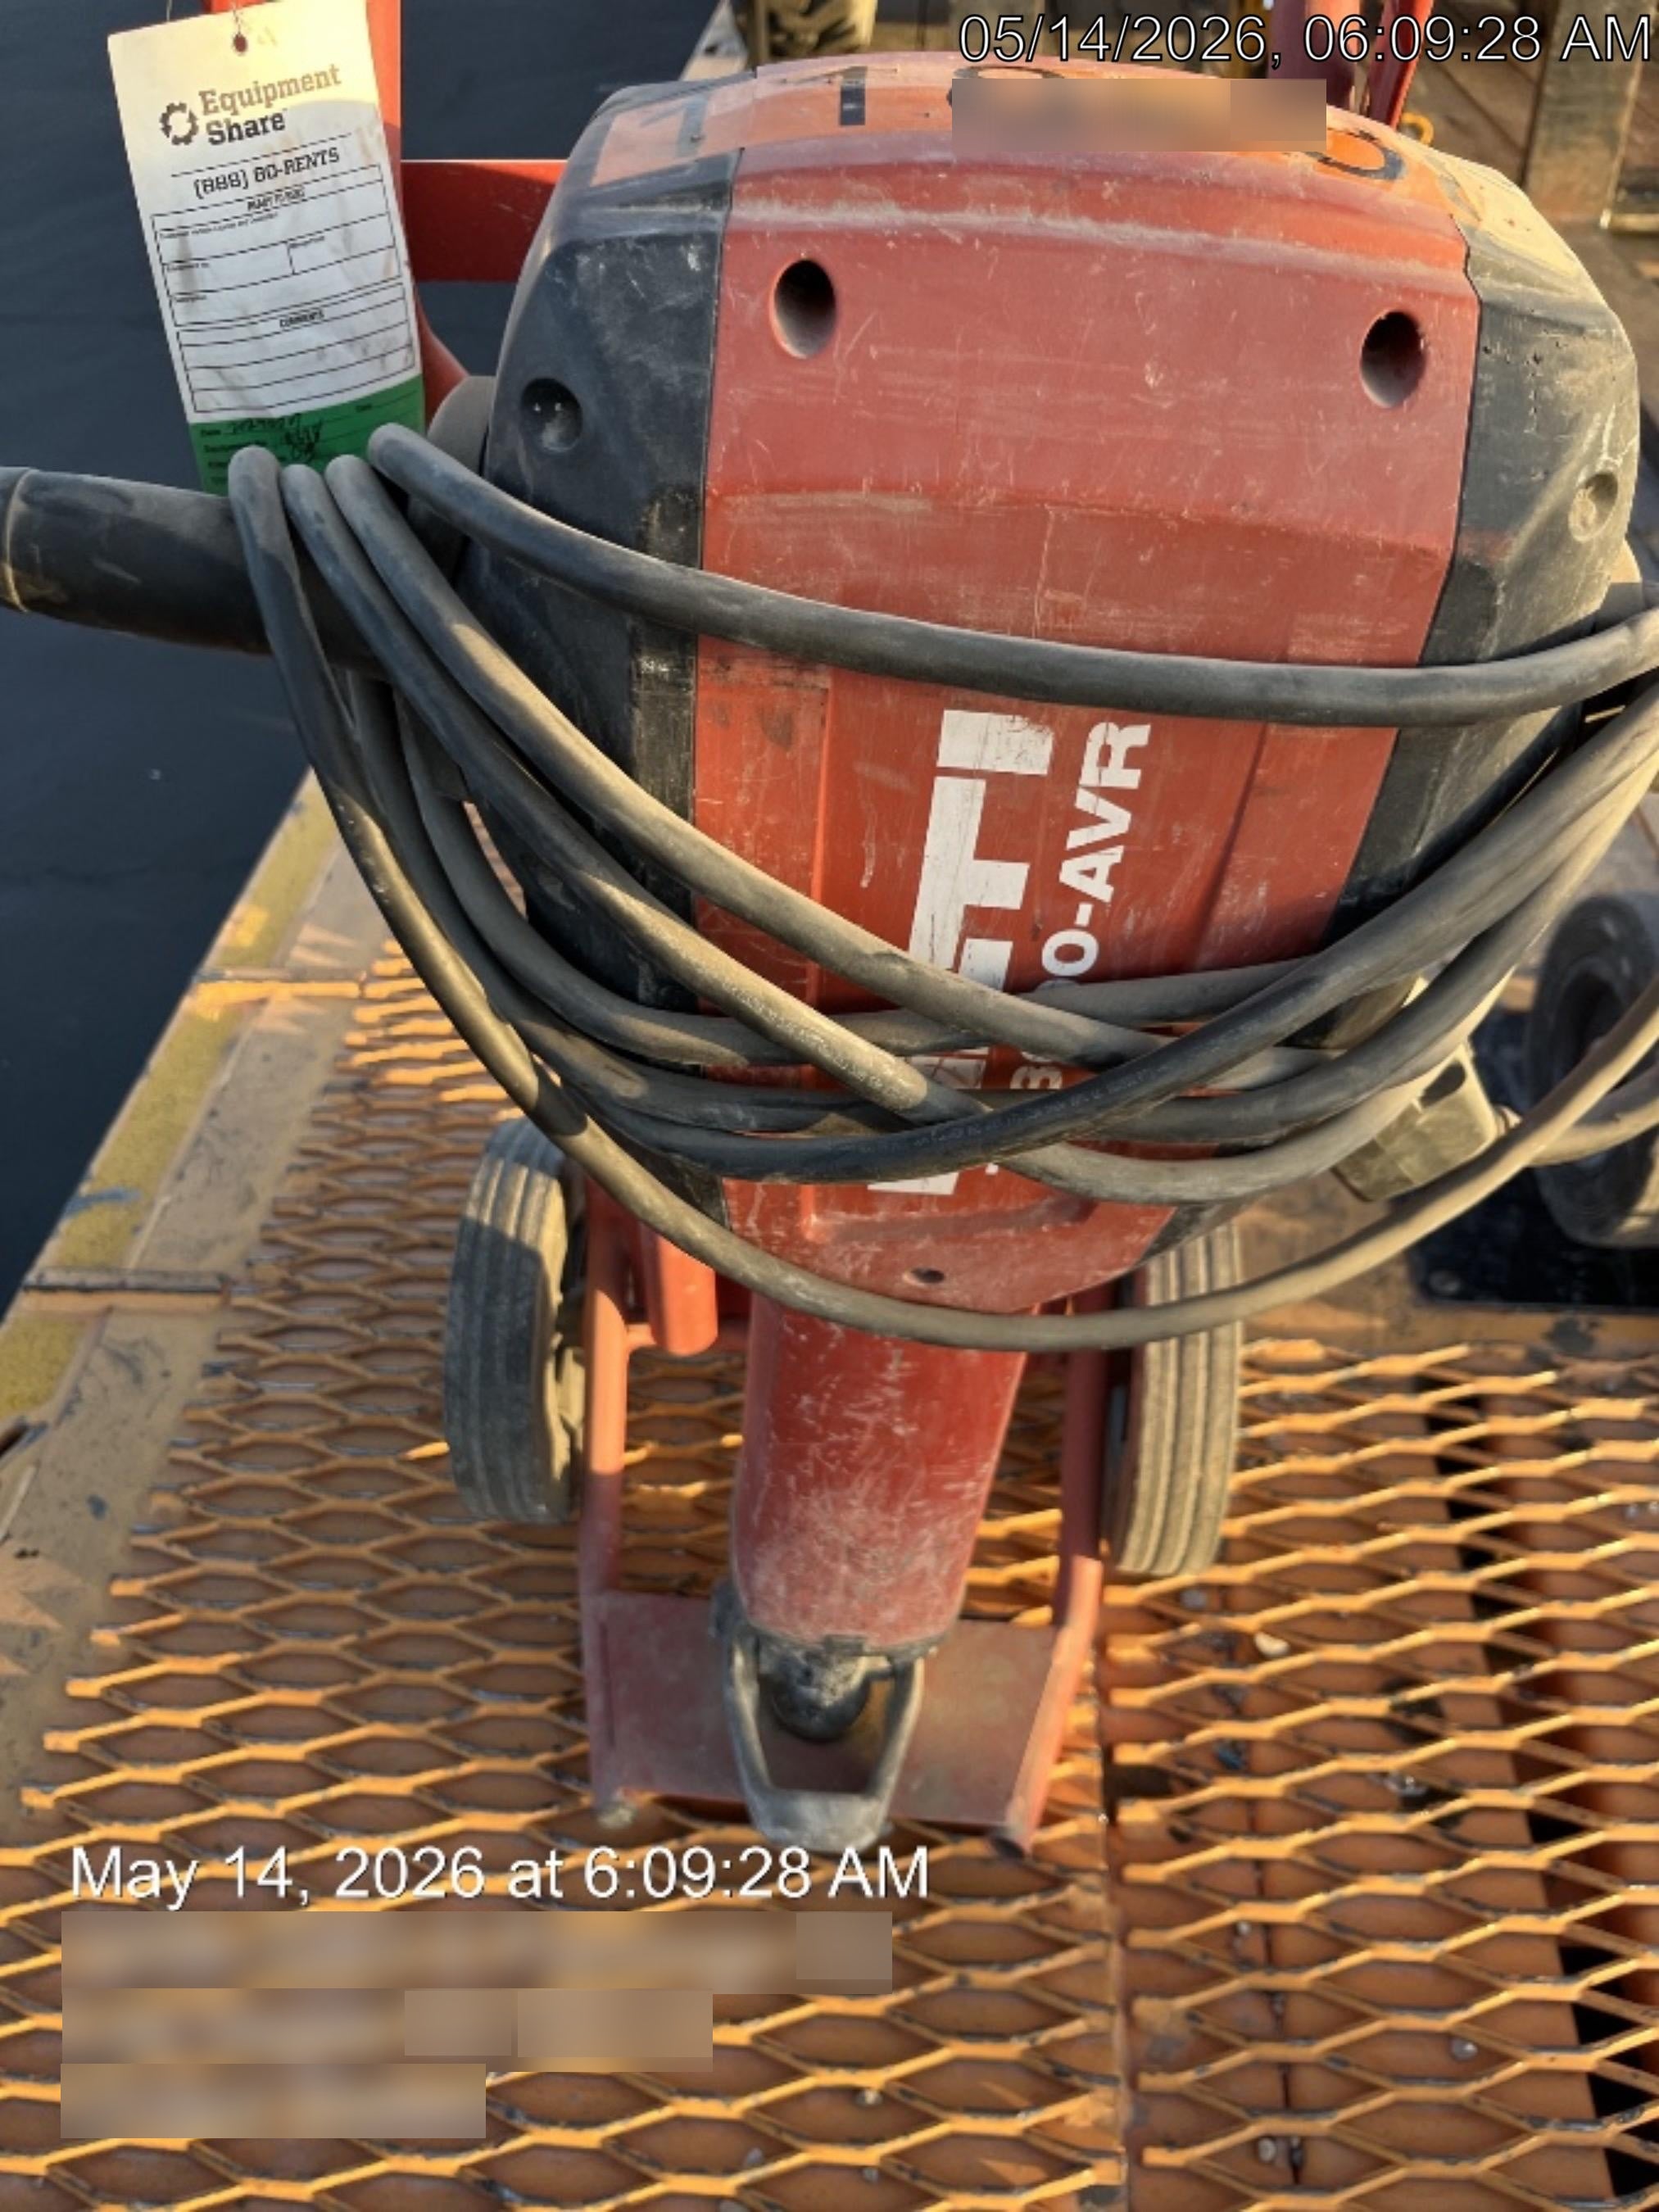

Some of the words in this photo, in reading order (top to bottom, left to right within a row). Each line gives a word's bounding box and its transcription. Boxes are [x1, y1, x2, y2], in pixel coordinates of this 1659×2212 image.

[198, 63, 342, 116] Equipment
[206, 111, 285, 146] Share
[193, 169, 249, 200] (888)
